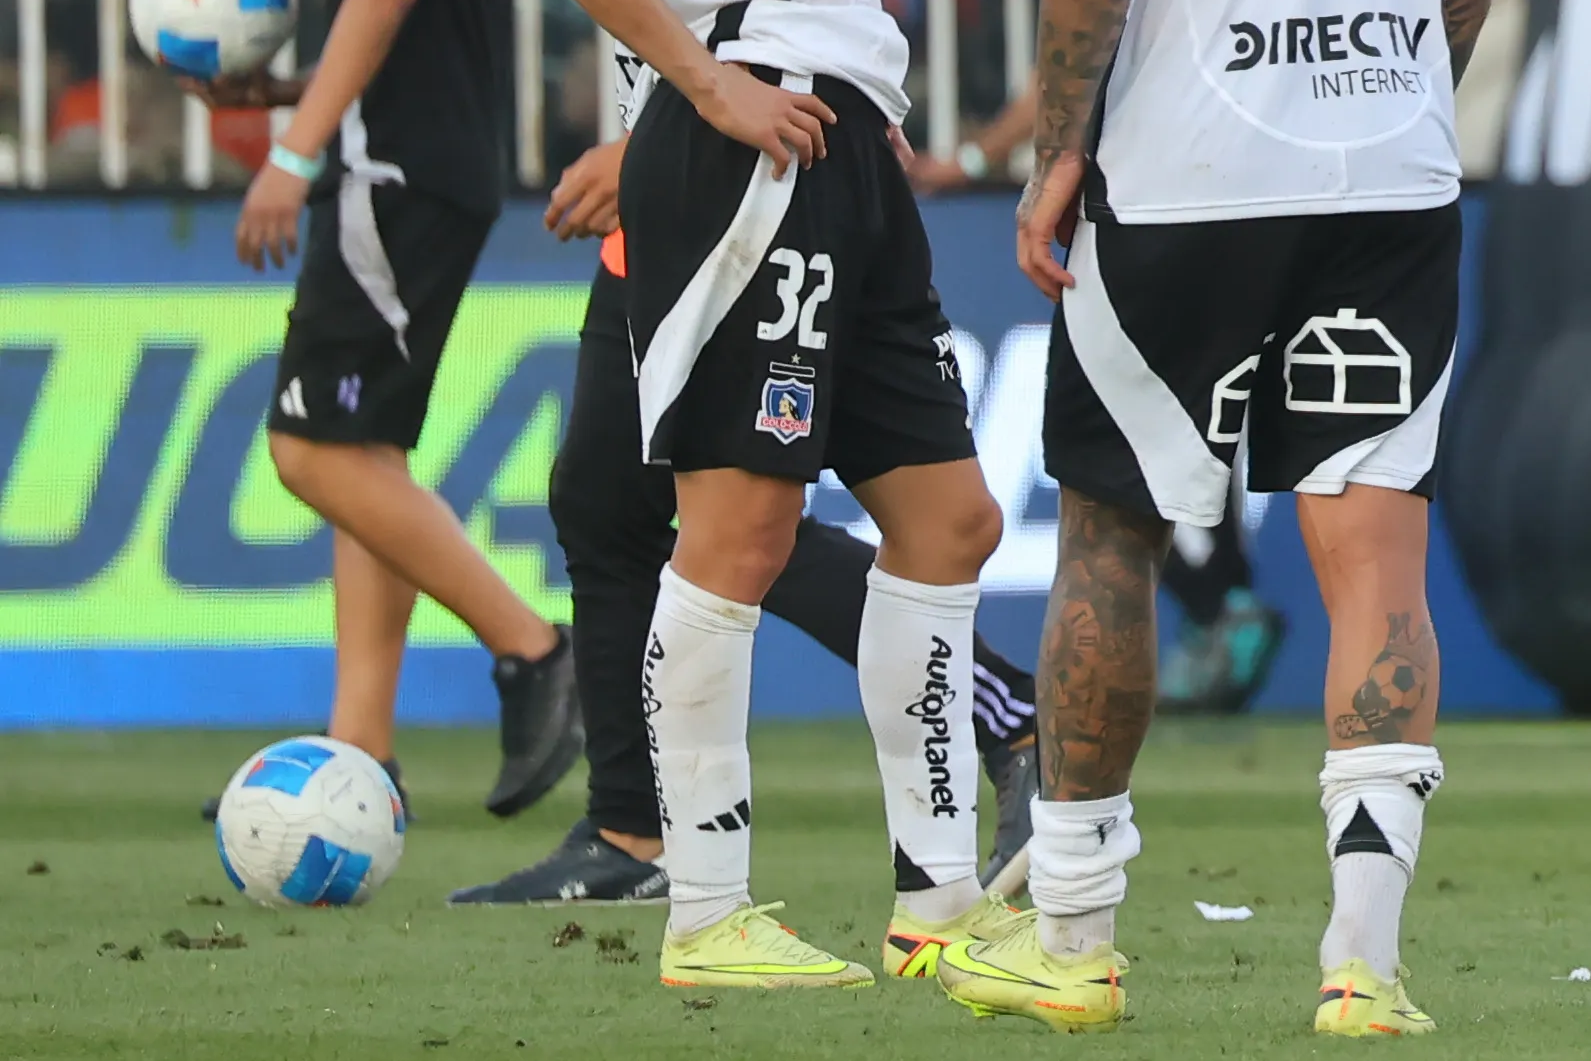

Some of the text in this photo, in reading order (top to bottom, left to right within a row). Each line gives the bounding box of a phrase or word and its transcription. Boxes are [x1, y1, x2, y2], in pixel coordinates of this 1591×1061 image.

[1224, 12, 1430, 72] DIRECTV
[1312, 66, 1427, 99] INTERNET
[757, 247, 834, 350] 32
[905, 634, 958, 819] Autoplanet
